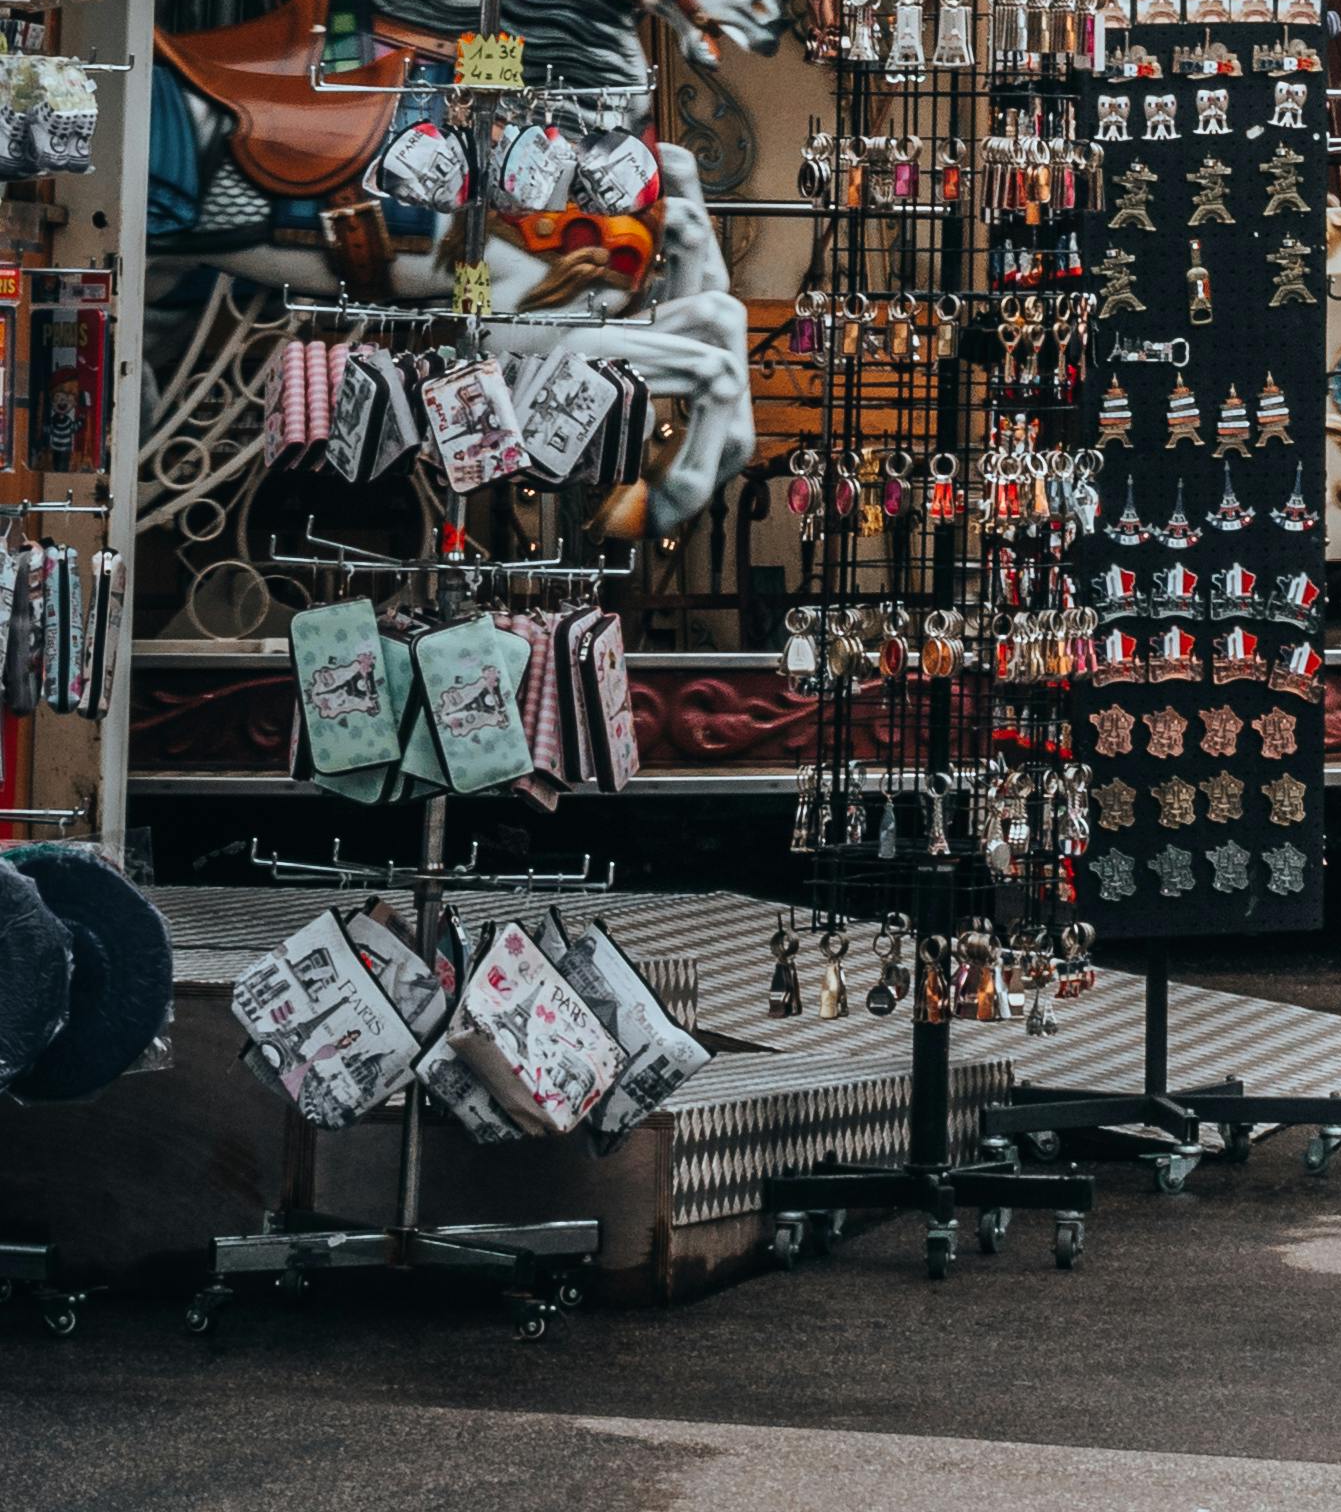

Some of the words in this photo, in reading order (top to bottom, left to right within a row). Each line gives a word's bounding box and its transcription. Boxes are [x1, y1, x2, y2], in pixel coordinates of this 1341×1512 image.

[470, 65, 482, 81] 4
[337, 979, 384, 1036] PARIS
[551, 985, 588, 1029] PARIS
